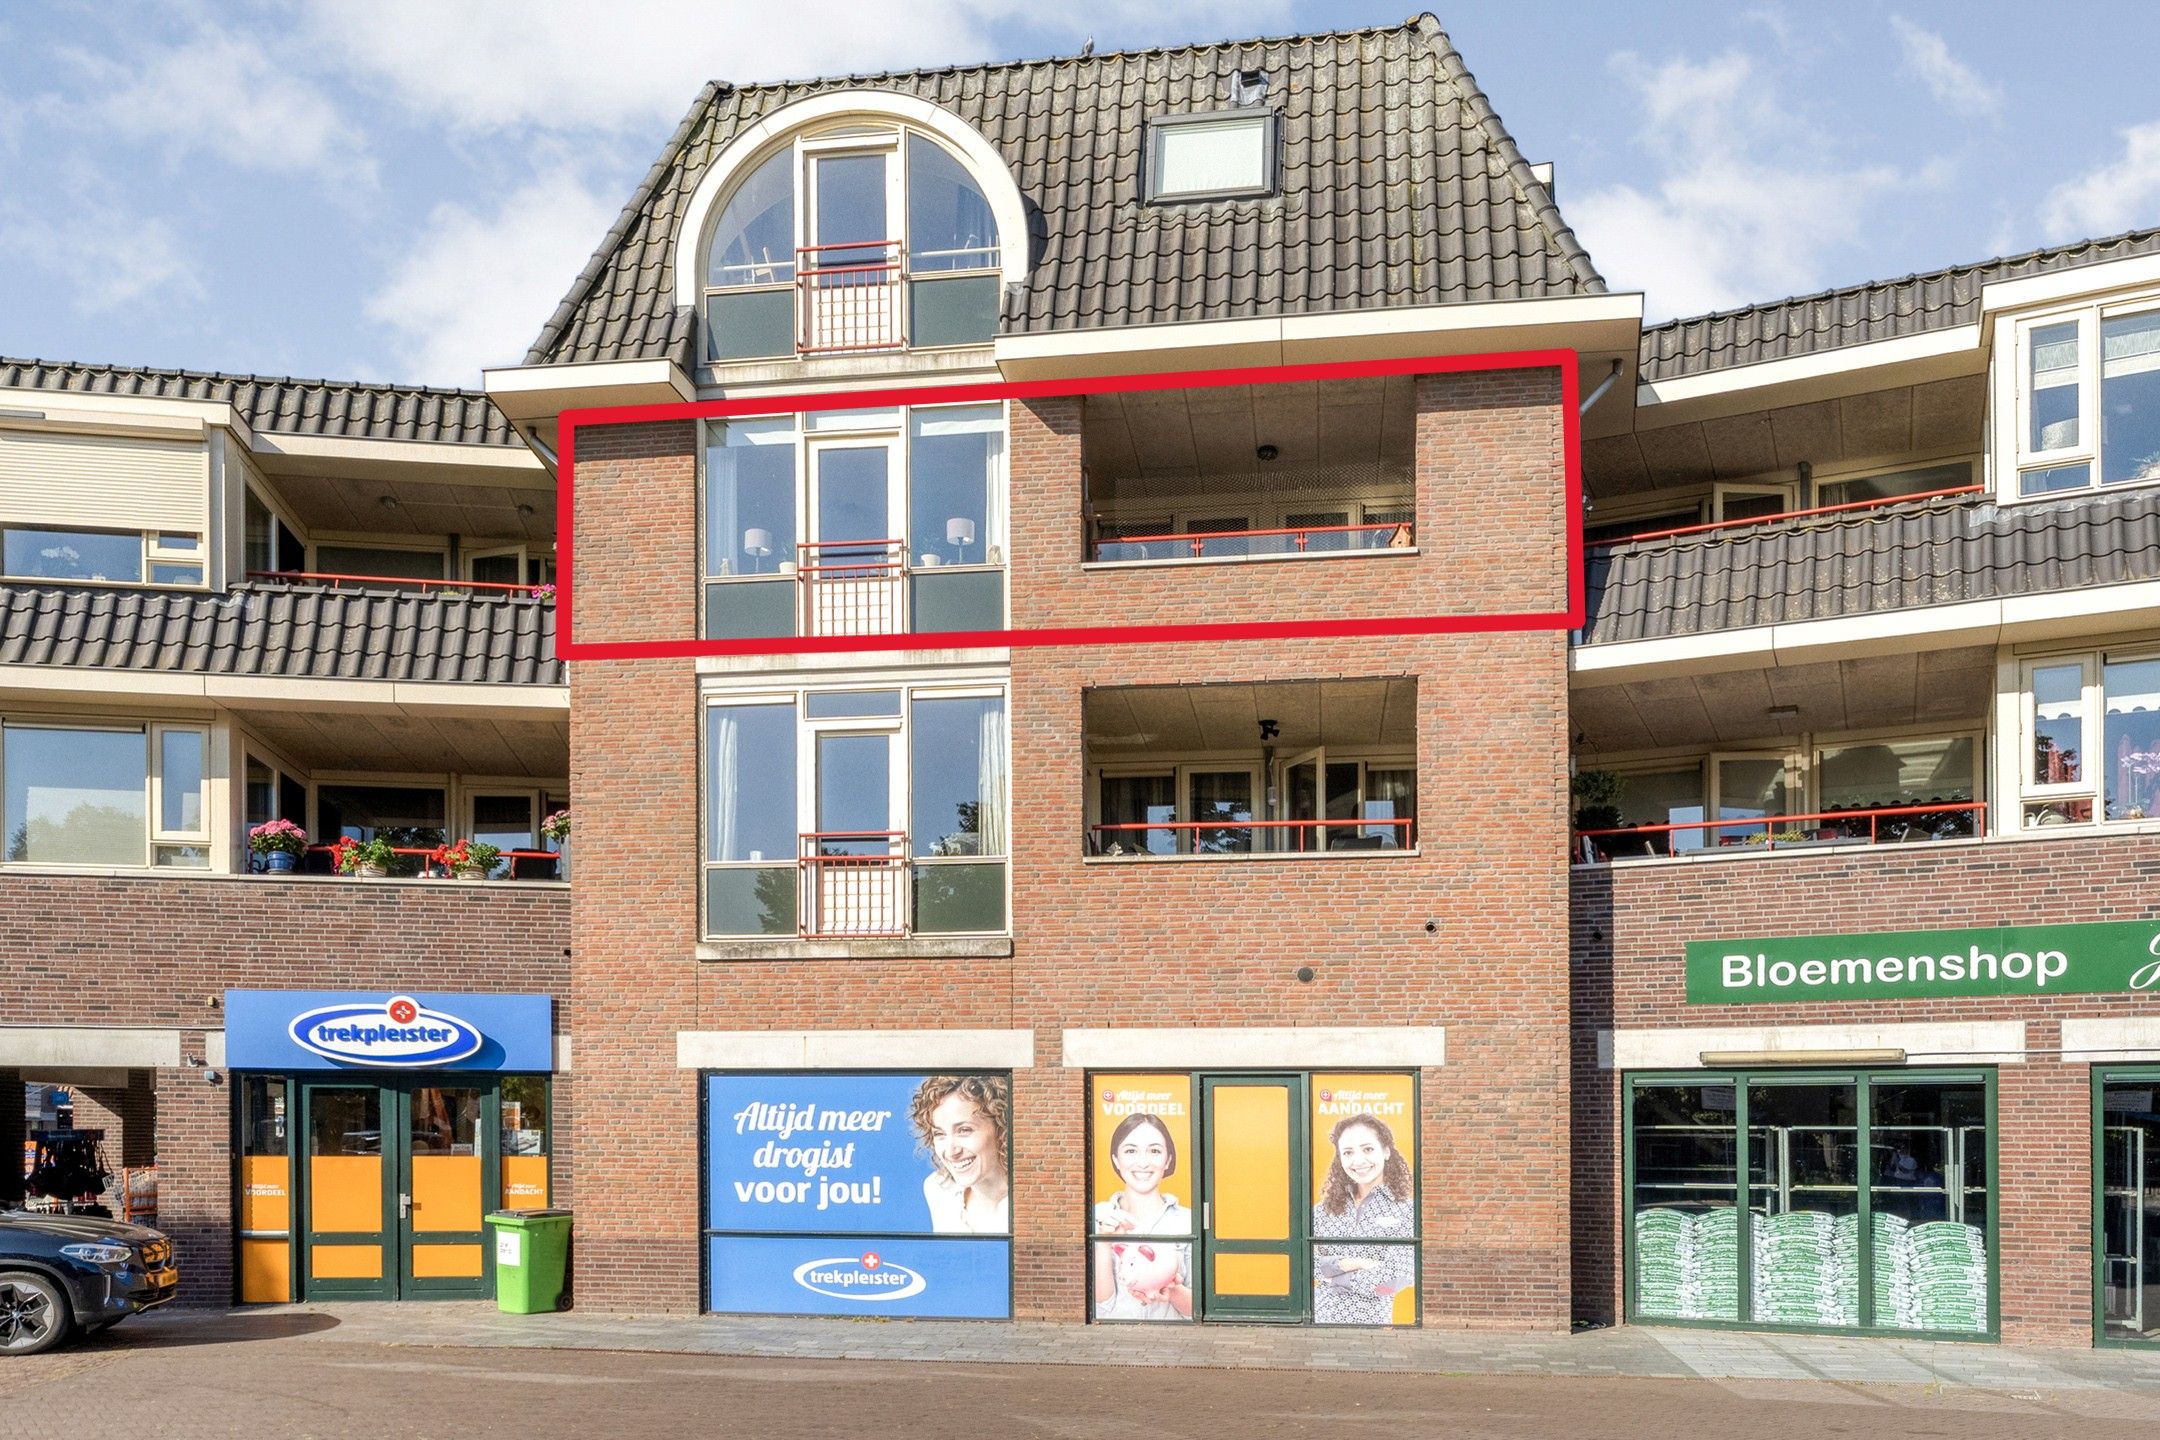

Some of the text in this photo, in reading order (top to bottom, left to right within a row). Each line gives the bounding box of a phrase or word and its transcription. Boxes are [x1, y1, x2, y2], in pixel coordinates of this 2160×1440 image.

[1721, 945, 2068, 987] Bloemenshop
[317, 1024, 452, 1046] trekpleister
[733, 1102, 892, 1140] Altijd meer
[1102, 1103, 1186, 1116] VOORDEEL
[1318, 1102, 1405, 1115] AANDACHT
[753, 1140, 855, 1177] drogist
[733, 1176, 881, 1211] voor jou!
[810, 1269, 907, 1288] trekpleister
